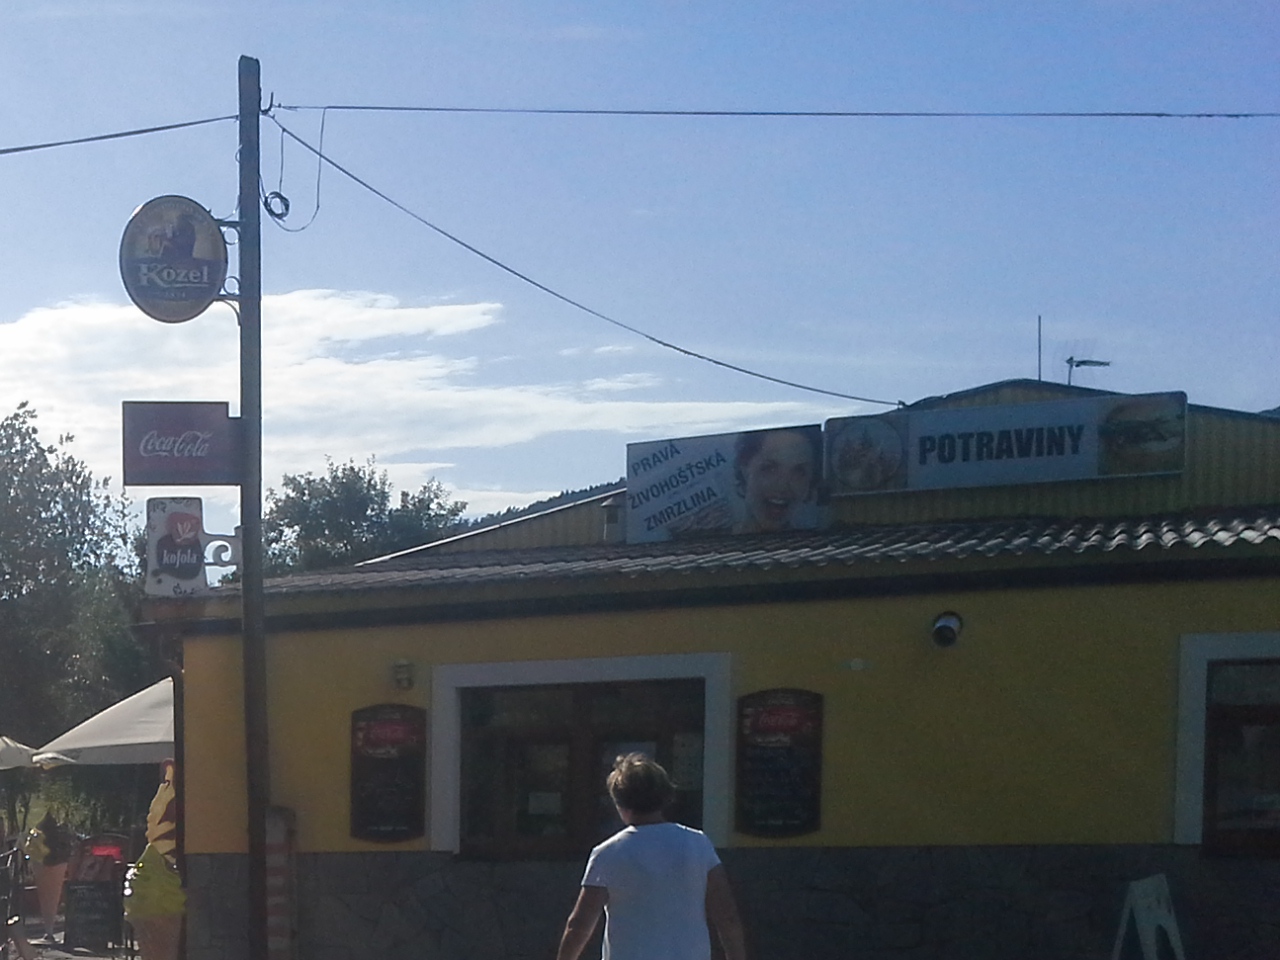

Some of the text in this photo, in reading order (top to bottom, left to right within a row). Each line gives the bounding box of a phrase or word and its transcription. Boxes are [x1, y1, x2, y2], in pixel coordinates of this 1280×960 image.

[138, 262, 209, 288] Kozel
[139, 430, 214, 458] Coca-Cola
[631, 440, 681, 476] PRAVÁ
[918, 424, 1085, 465] POTRAVINY
[628, 449, 727, 509] ŽIVOHOŠŤSKÁ
[644, 486, 718, 531] ZMRZLINA
[162, 547, 198, 569] kofola
